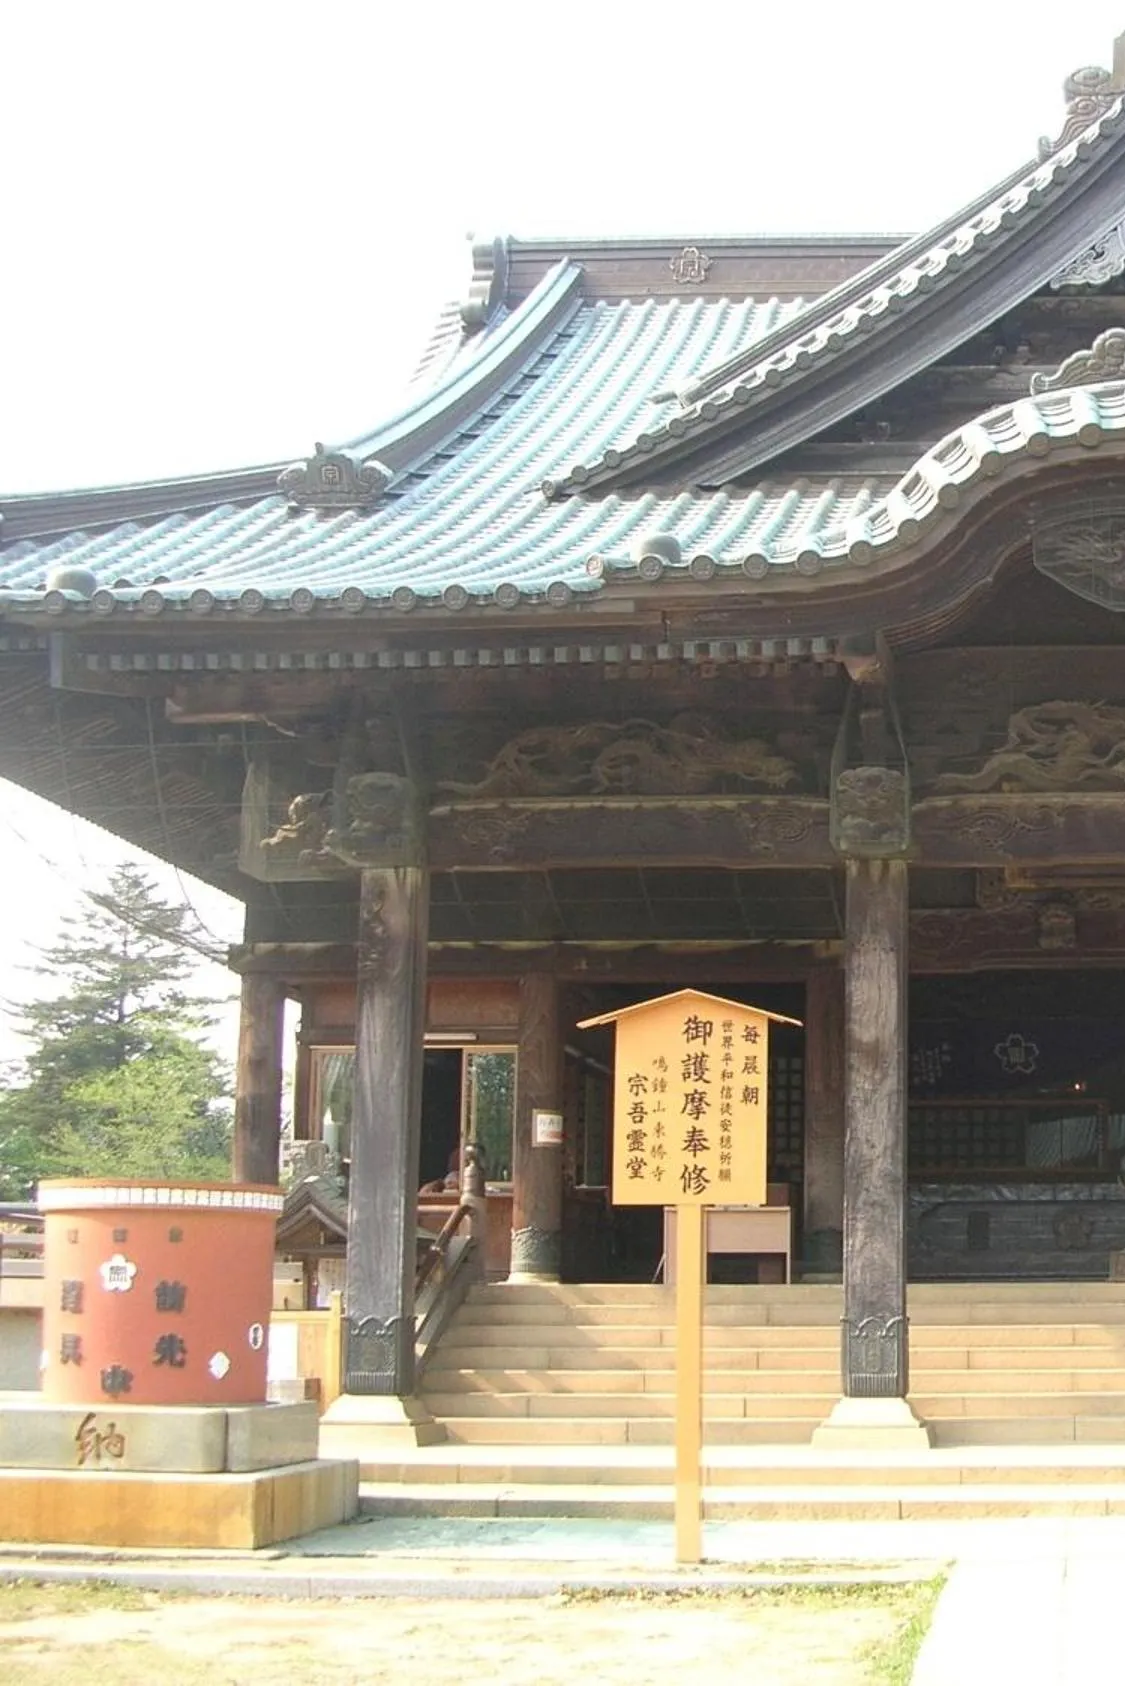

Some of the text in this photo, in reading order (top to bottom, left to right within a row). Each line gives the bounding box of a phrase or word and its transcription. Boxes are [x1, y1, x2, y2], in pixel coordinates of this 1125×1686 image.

[680, 1014, 713, 1196] 御護摩奉修
[740, 1024, 761, 1106] 毎晨朝
